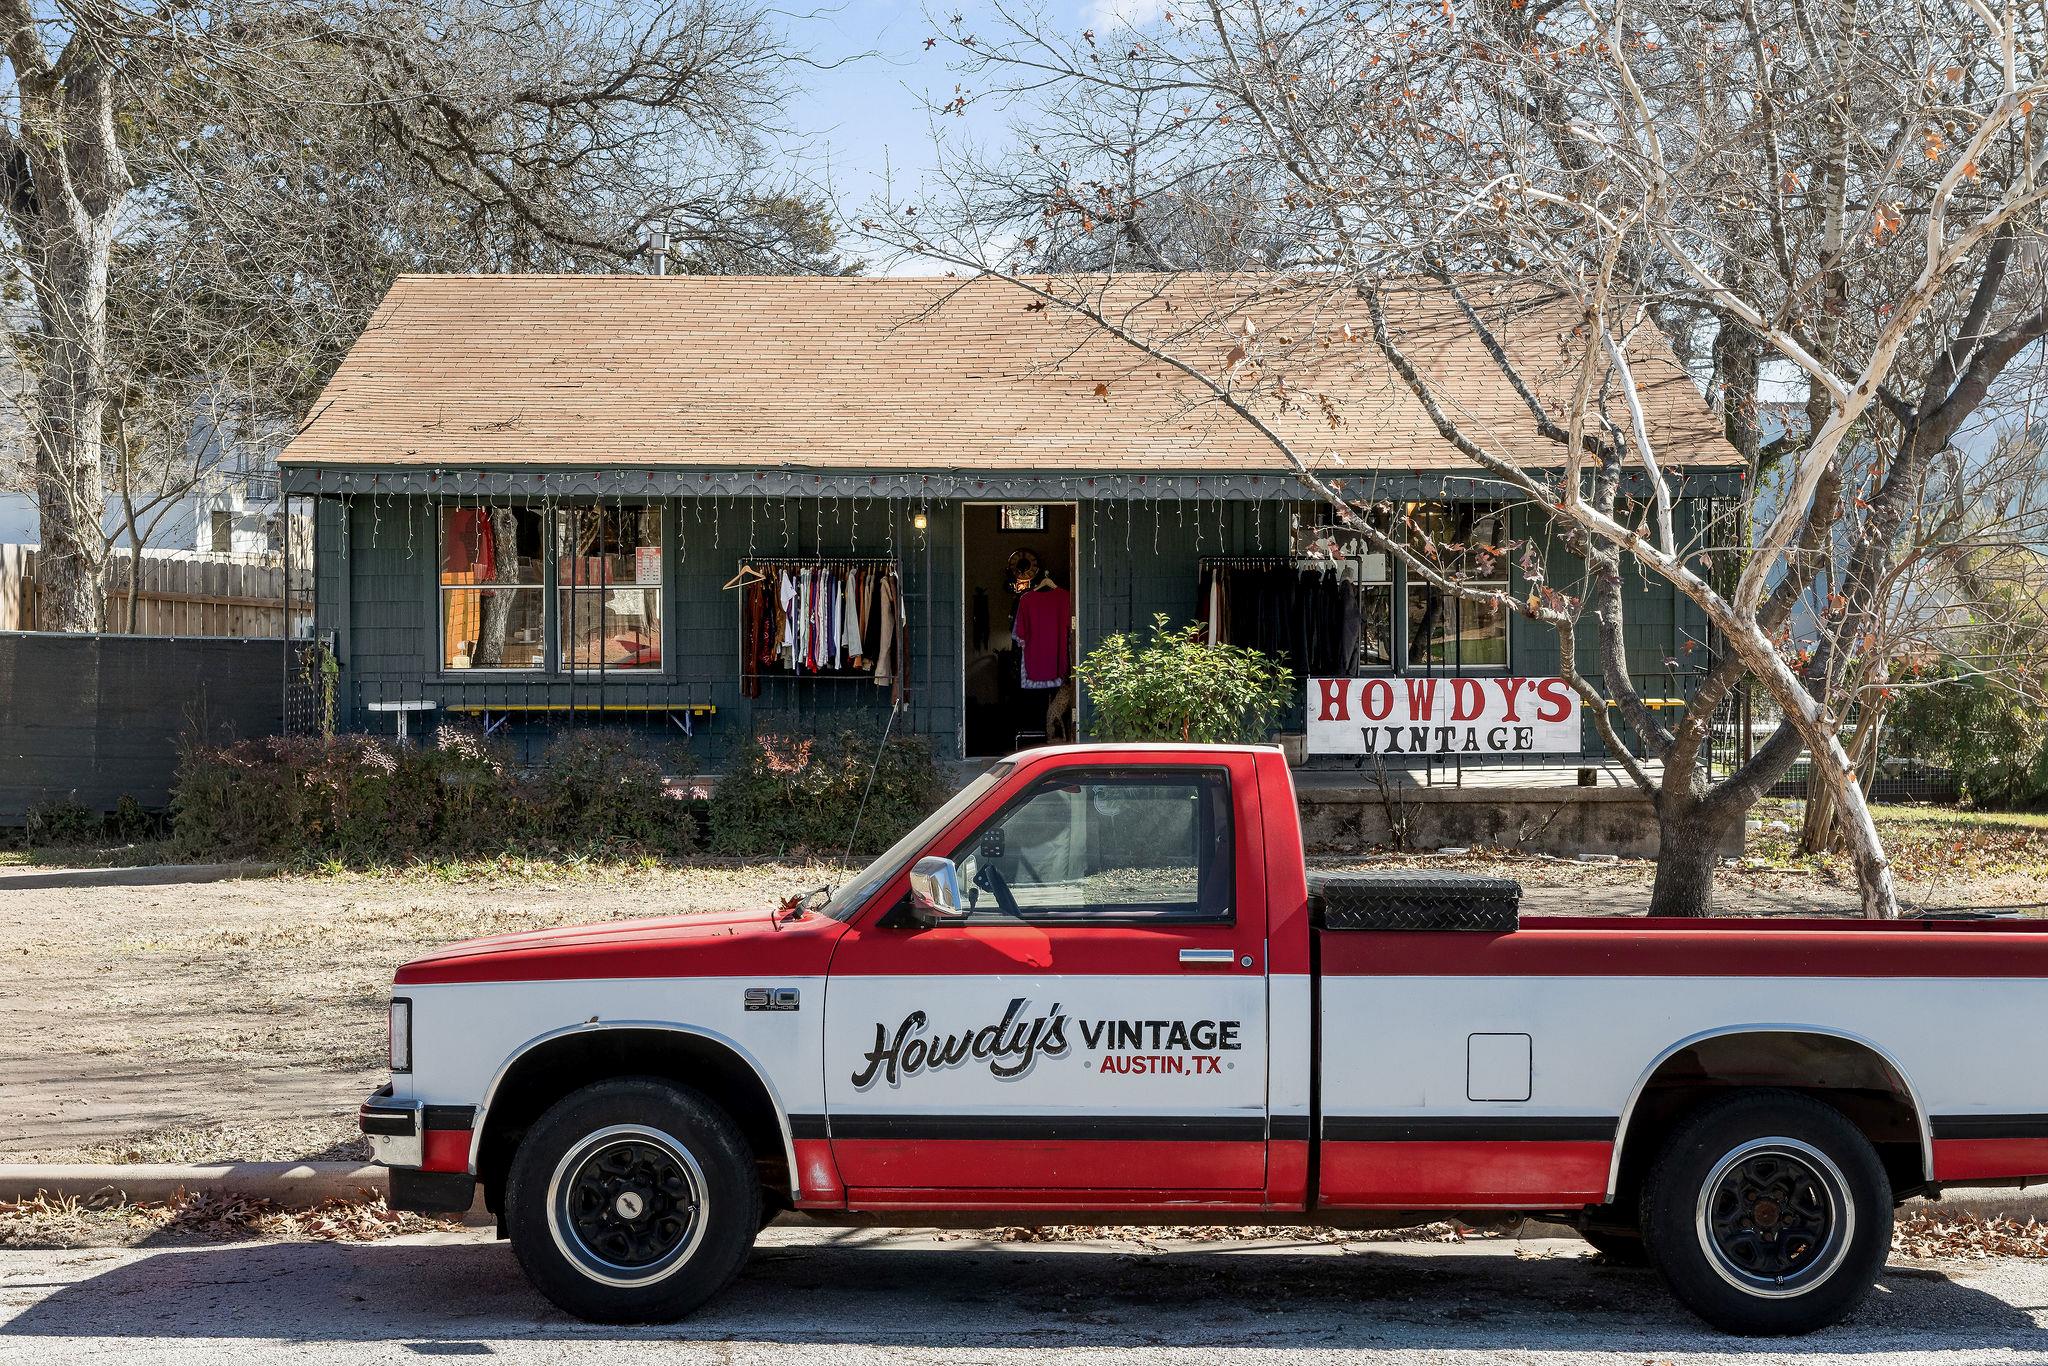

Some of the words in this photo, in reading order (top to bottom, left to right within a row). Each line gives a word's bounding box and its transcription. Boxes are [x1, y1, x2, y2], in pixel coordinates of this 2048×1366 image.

[1317, 678, 1573, 723] HOWDY'S
[1361, 726, 1534, 753] VINTAGE
[745, 988, 800, 1005] S10
[851, 997, 1071, 1091] Howdy's
[1079, 1019, 1242, 1051] VINTAGE
